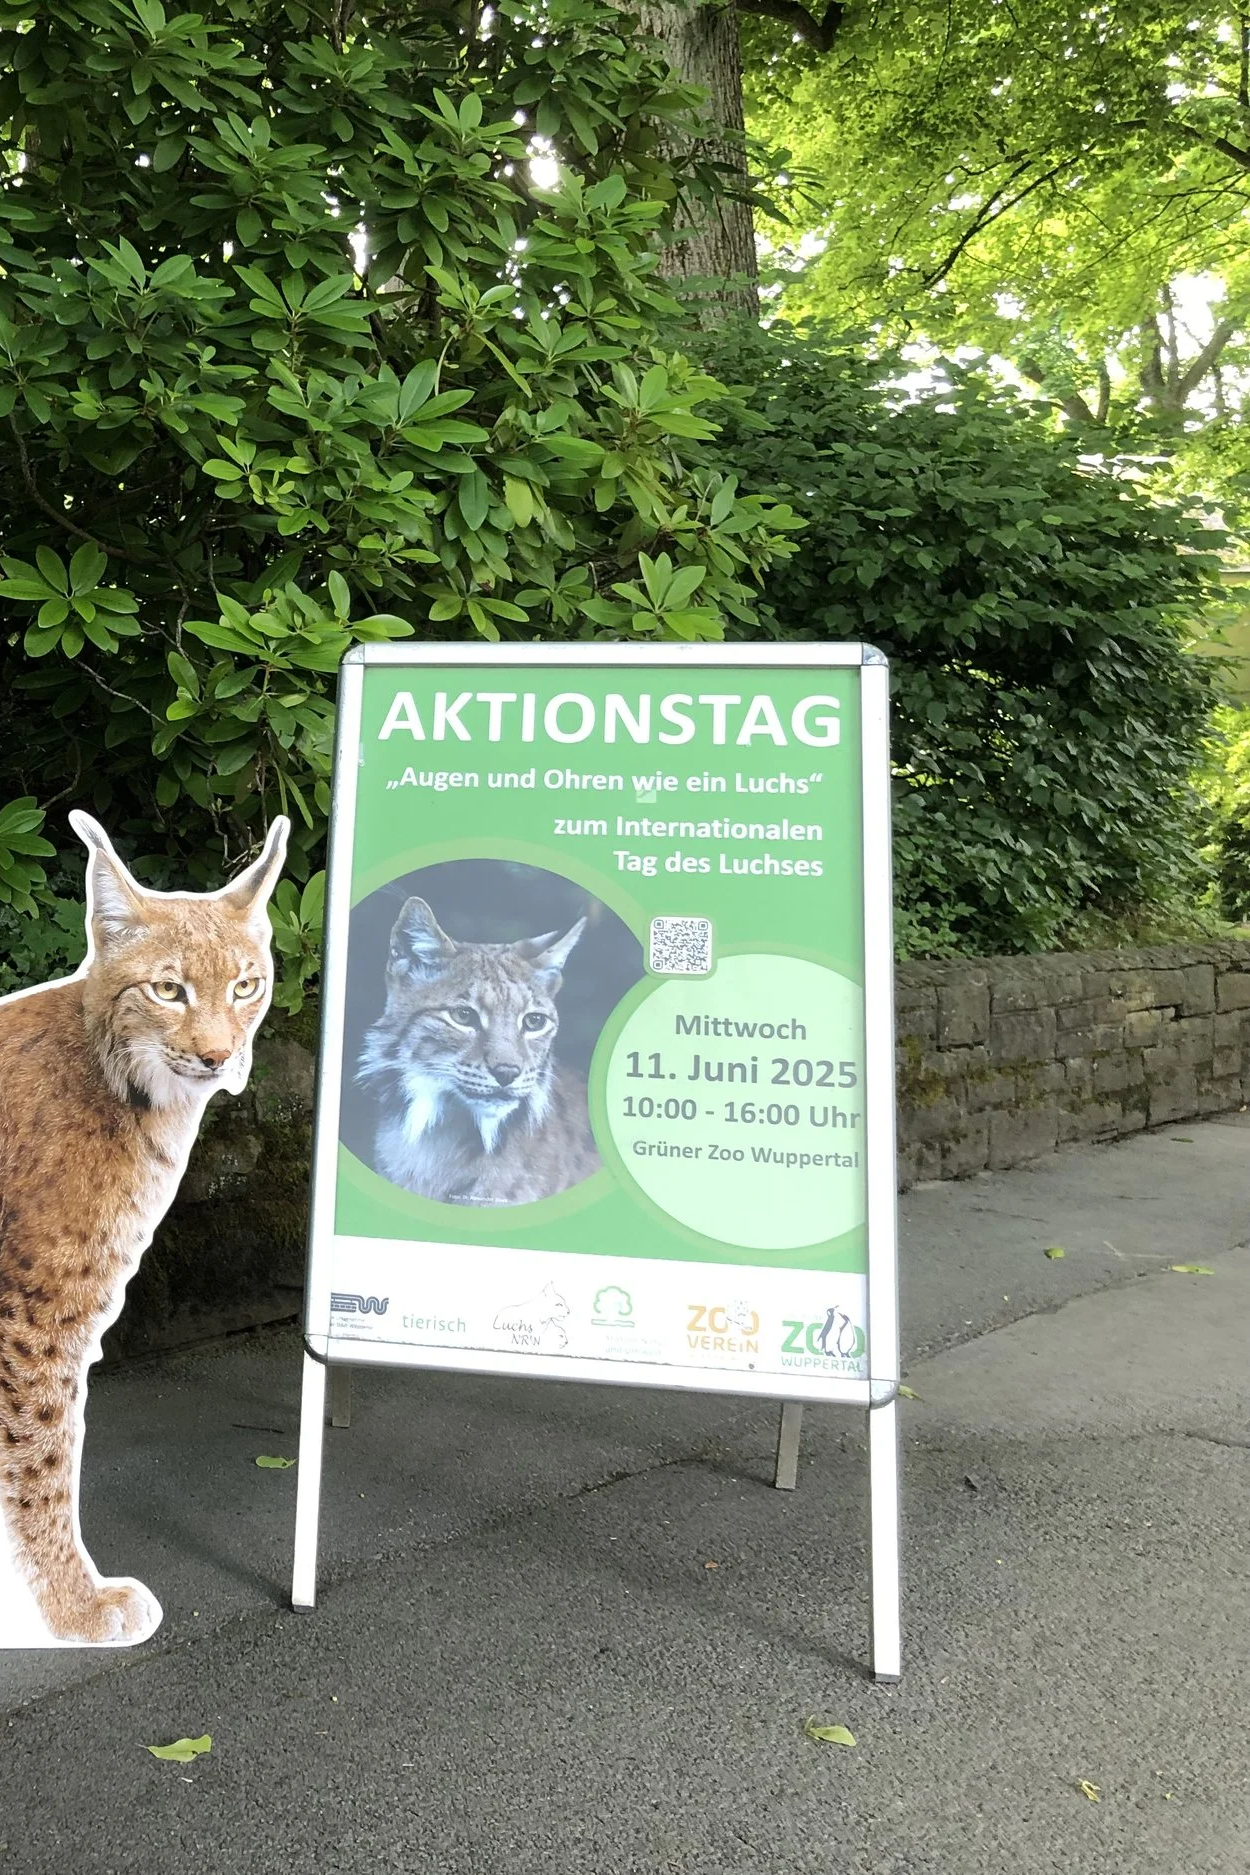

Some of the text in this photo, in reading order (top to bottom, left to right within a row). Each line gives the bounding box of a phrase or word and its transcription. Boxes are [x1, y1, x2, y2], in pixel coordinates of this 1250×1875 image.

[378, 691, 841, 747] AKTIONSTAG
[386, 767, 823, 795] „Augen und Ohren wie ein Luchs“
[554, 815, 823, 841] zum Internationalen
[613, 851, 823, 877] Tag des Luchses
[675, 1014, 807, 1040] Mittwoch
[626, 1052, 858, 1088] 11. Juni 2025
[622, 1096, 697, 1120] 10:00
[724, 1101, 800, 1126] 16:00
[809, 1106, 861, 1128] Uhr
[632, 1140, 859, 1168] Grüner Zoo Wuppertal
[403, 1315, 466, 1333] tierisch
[781, 1356, 865, 1373] WUPPERTAL
